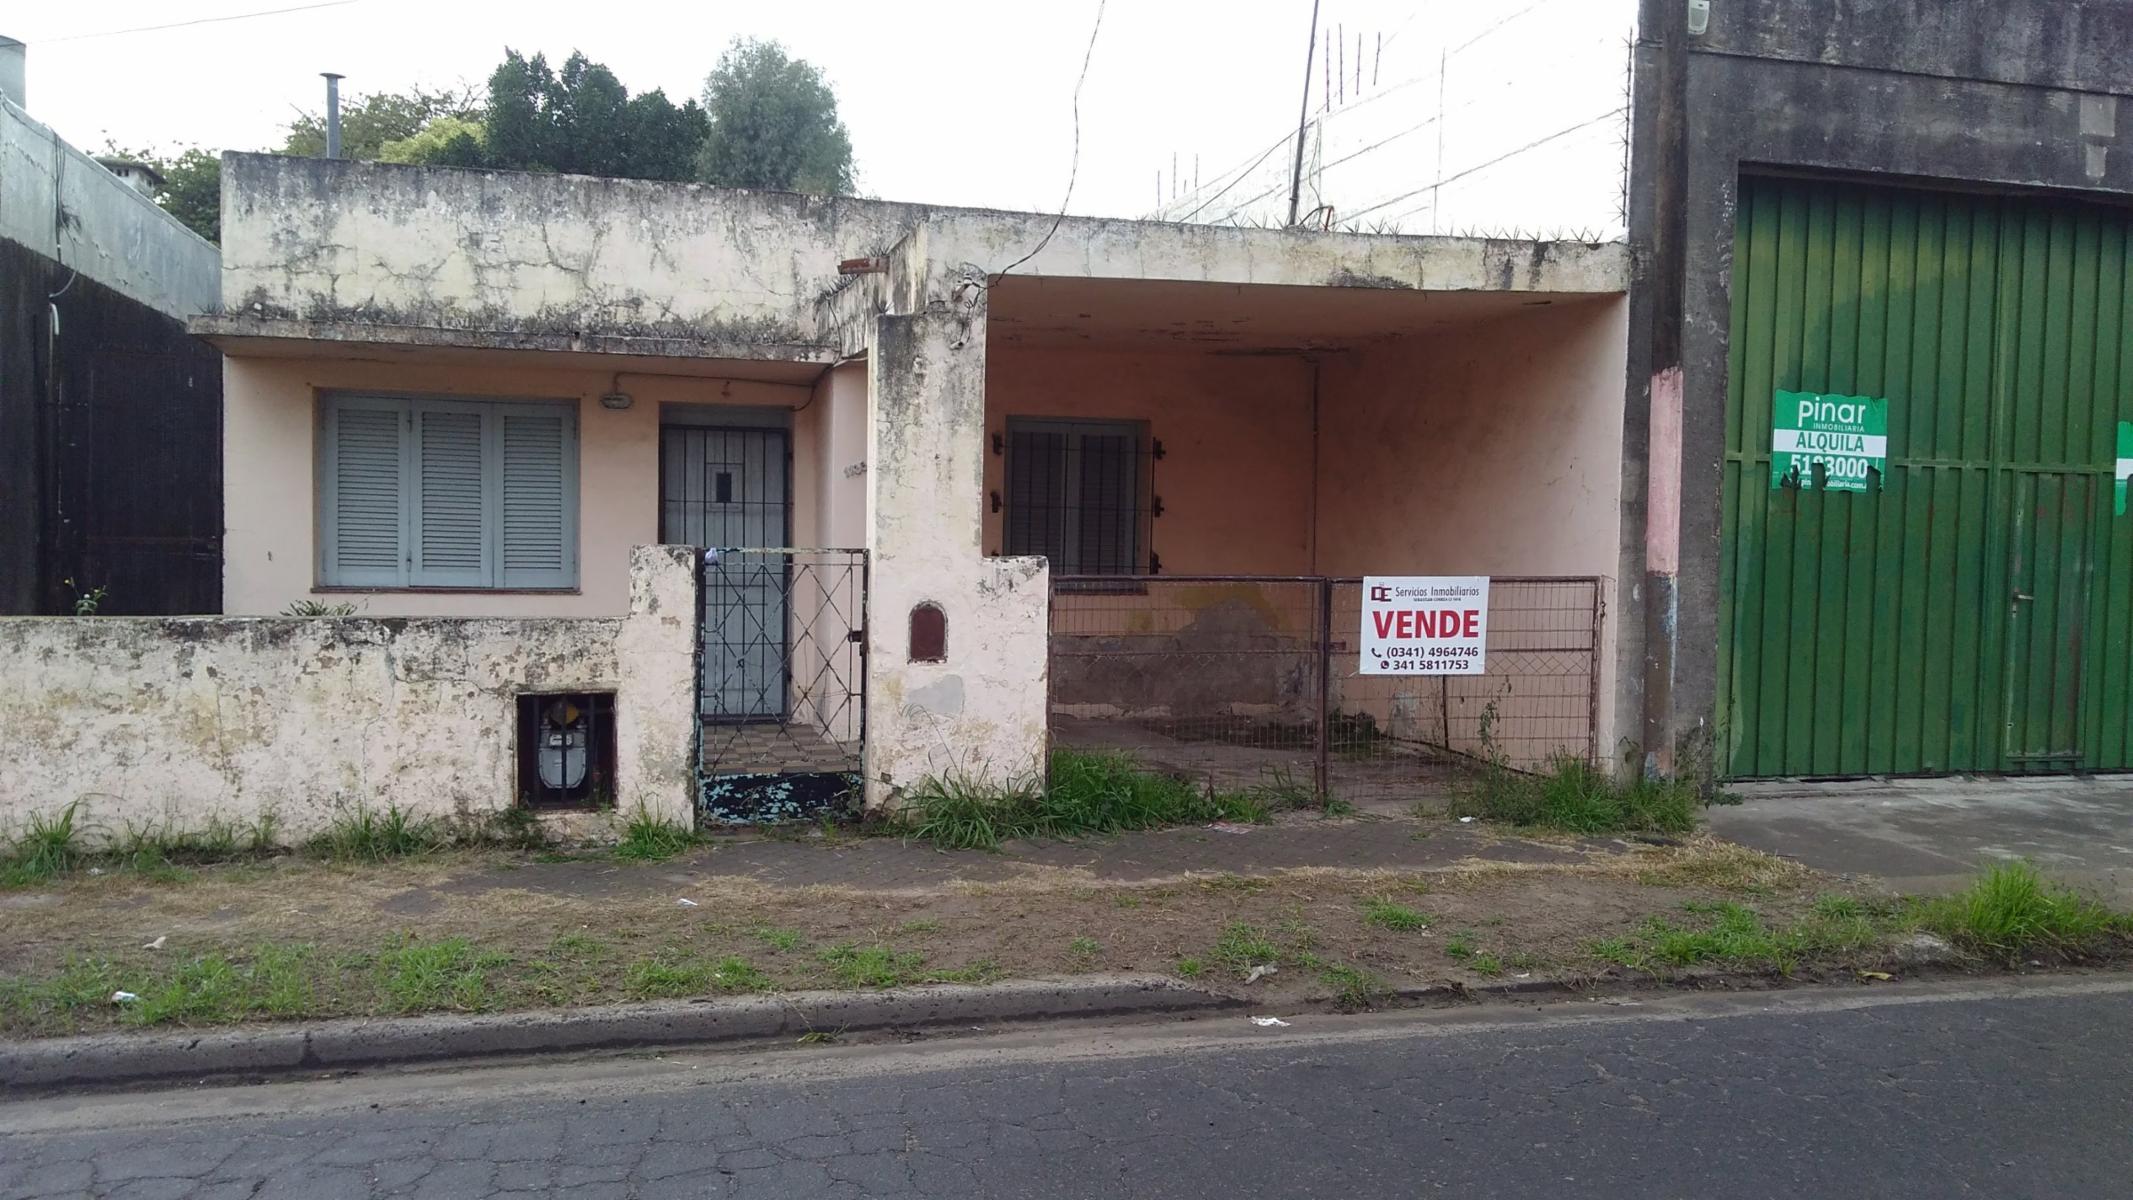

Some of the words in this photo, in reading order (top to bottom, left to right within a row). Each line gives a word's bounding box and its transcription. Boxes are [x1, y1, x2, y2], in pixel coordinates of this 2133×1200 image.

[1798, 397, 1866, 428] pinar
[1813, 422, 1865, 432] INMOBILIARIA
[1796, 431, 1865, 453] ALQUILA
[1395, 586, 1428, 597] Servicios
[1430, 585, 1480, 597] Inmobiliarios
[1372, 609, 1480, 639] VENDE
[1386, 647, 1425, 659] (0341)
[1428, 646, 1479, 657] 4964746
[1393, 660, 1415, 670] 341
[1419, 660, 1469, 670] 5811753
